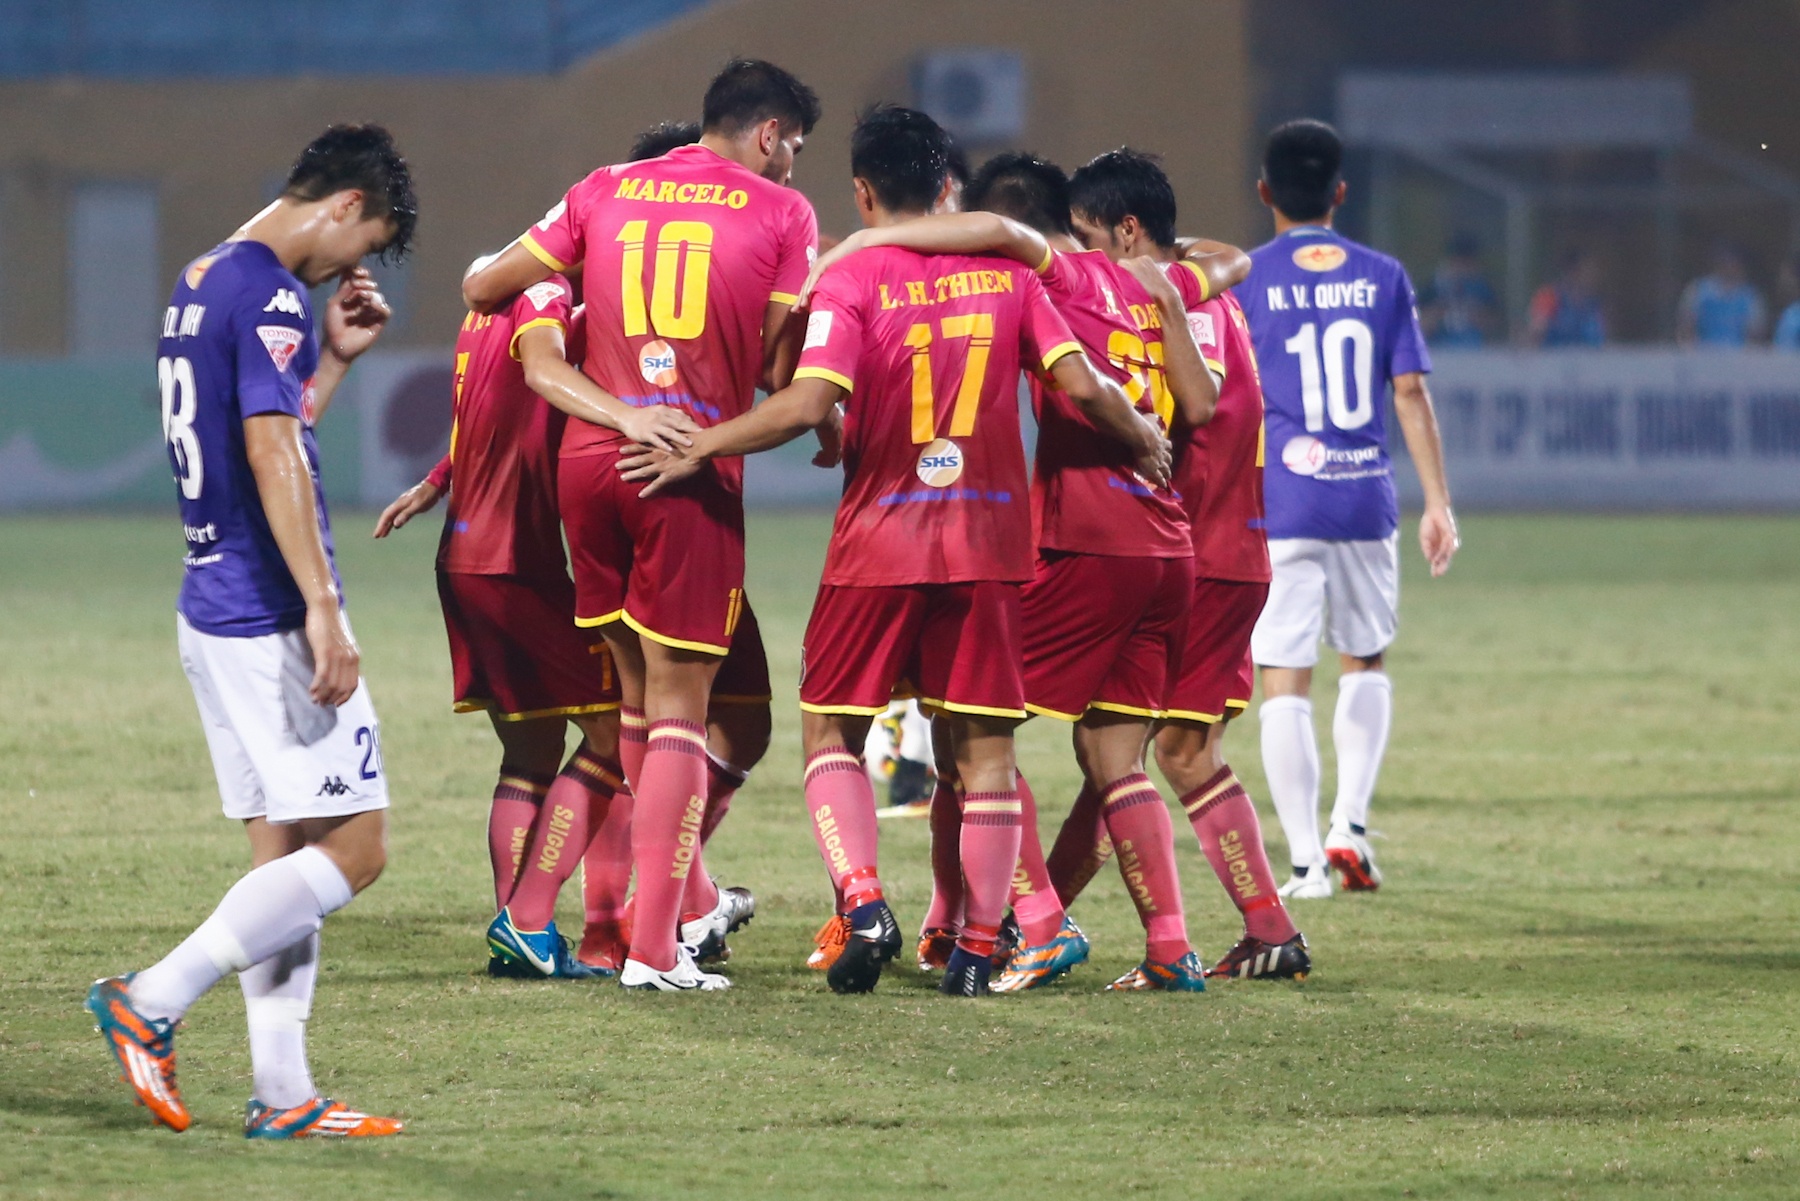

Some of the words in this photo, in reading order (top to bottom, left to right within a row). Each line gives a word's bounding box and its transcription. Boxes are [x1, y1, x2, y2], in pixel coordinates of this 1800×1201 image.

[613, 177, 749, 210] MARCELO
[615, 220, 714, 340] 10
[1267, 286, 1289, 311] N.
[1292, 284, 1310, 309] V.
[904, 314, 993, 445] 17
[1285, 318, 1374, 433] 10
[920, 456, 958, 468] SHS
[536, 804, 574, 873] SAIGON
[670, 795, 704, 879] SAIGON
[815, 804, 850, 874] SAIGON
[1219, 830, 1262, 899] SAIGON
[1118, 839, 1158, 912] SAIGON
